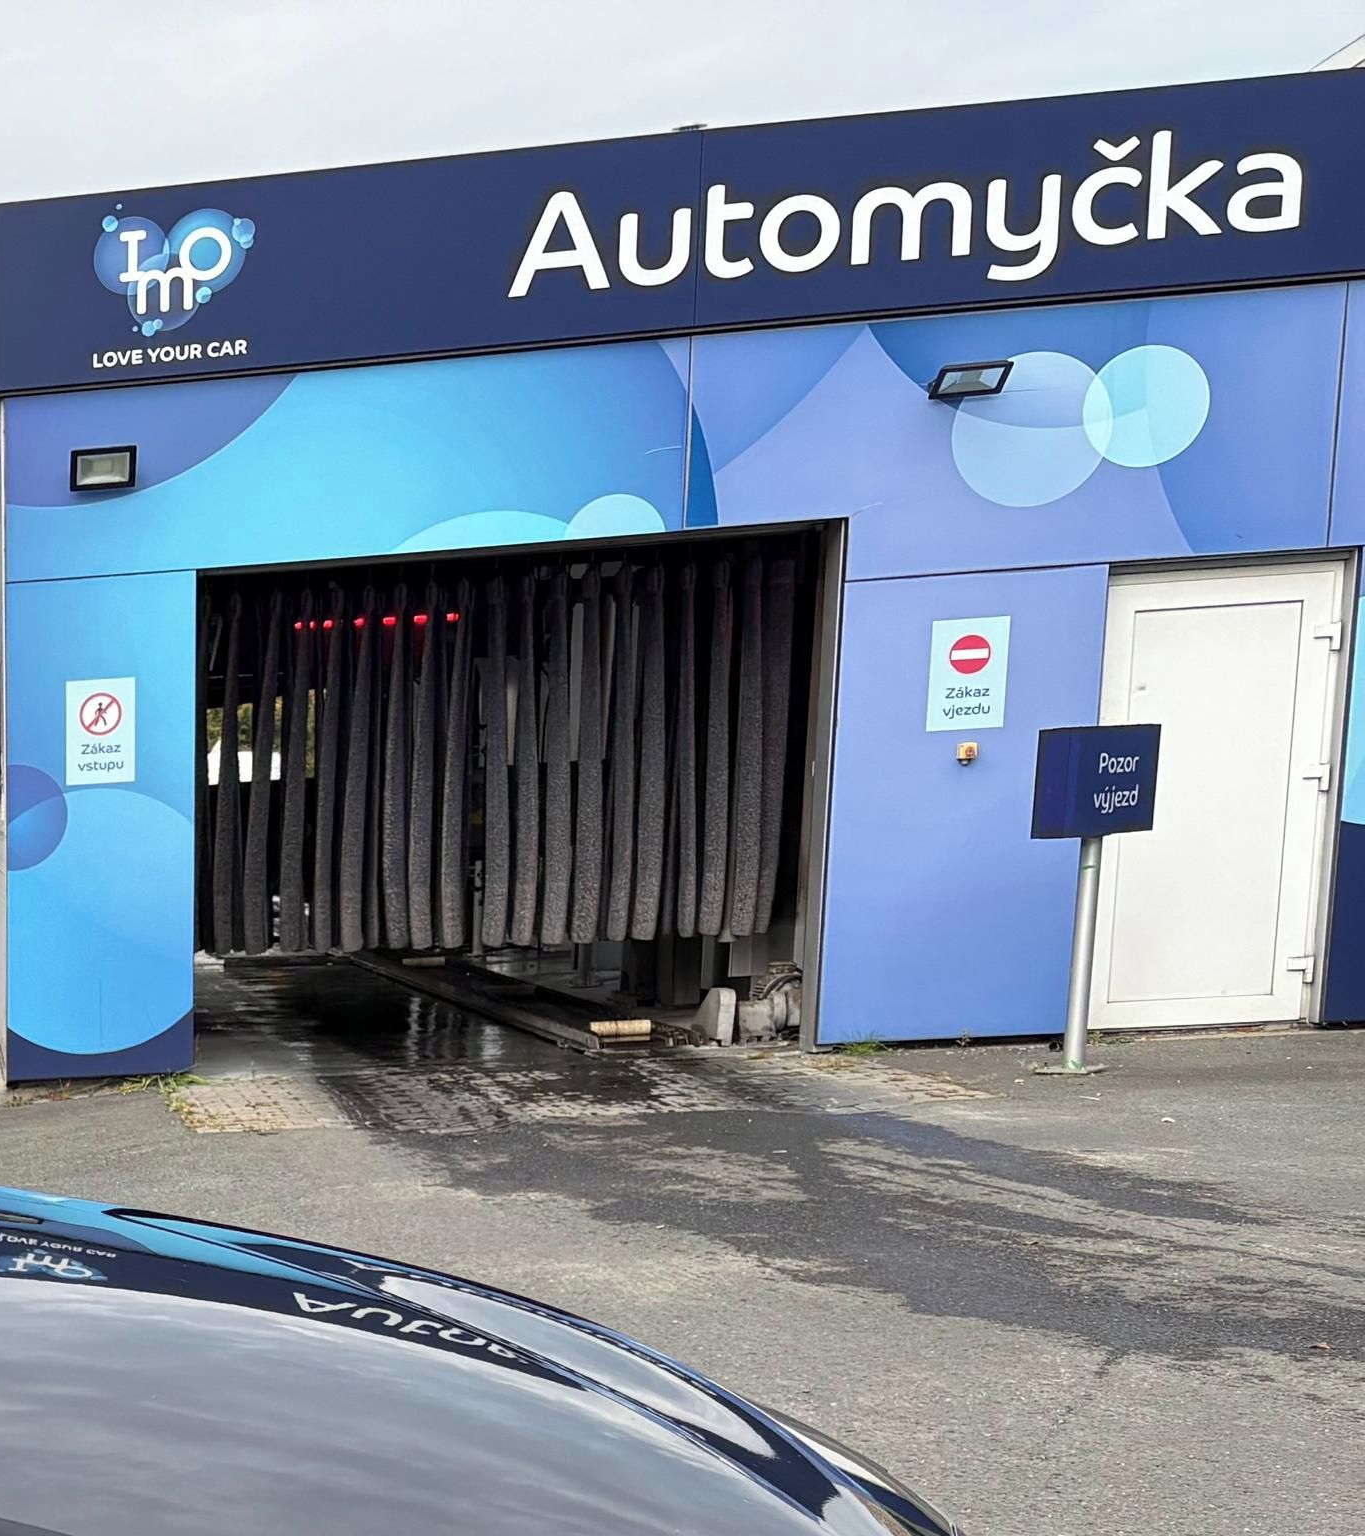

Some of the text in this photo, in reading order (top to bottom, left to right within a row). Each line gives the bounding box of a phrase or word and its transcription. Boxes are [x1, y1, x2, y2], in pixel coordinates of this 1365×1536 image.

[507, 129, 1304, 299] Automyčka
[92, 339, 248, 369] LOVE YOUR CAR
[945, 686, 990, 699] Zákaz
[943, 703, 991, 719] vjezdu
[81, 743, 121, 754] Zákaz
[78, 761, 124, 772] vstupu
[1098, 752, 1140, 775] Pozor
[1093, 784, 1139, 814] výjezd
